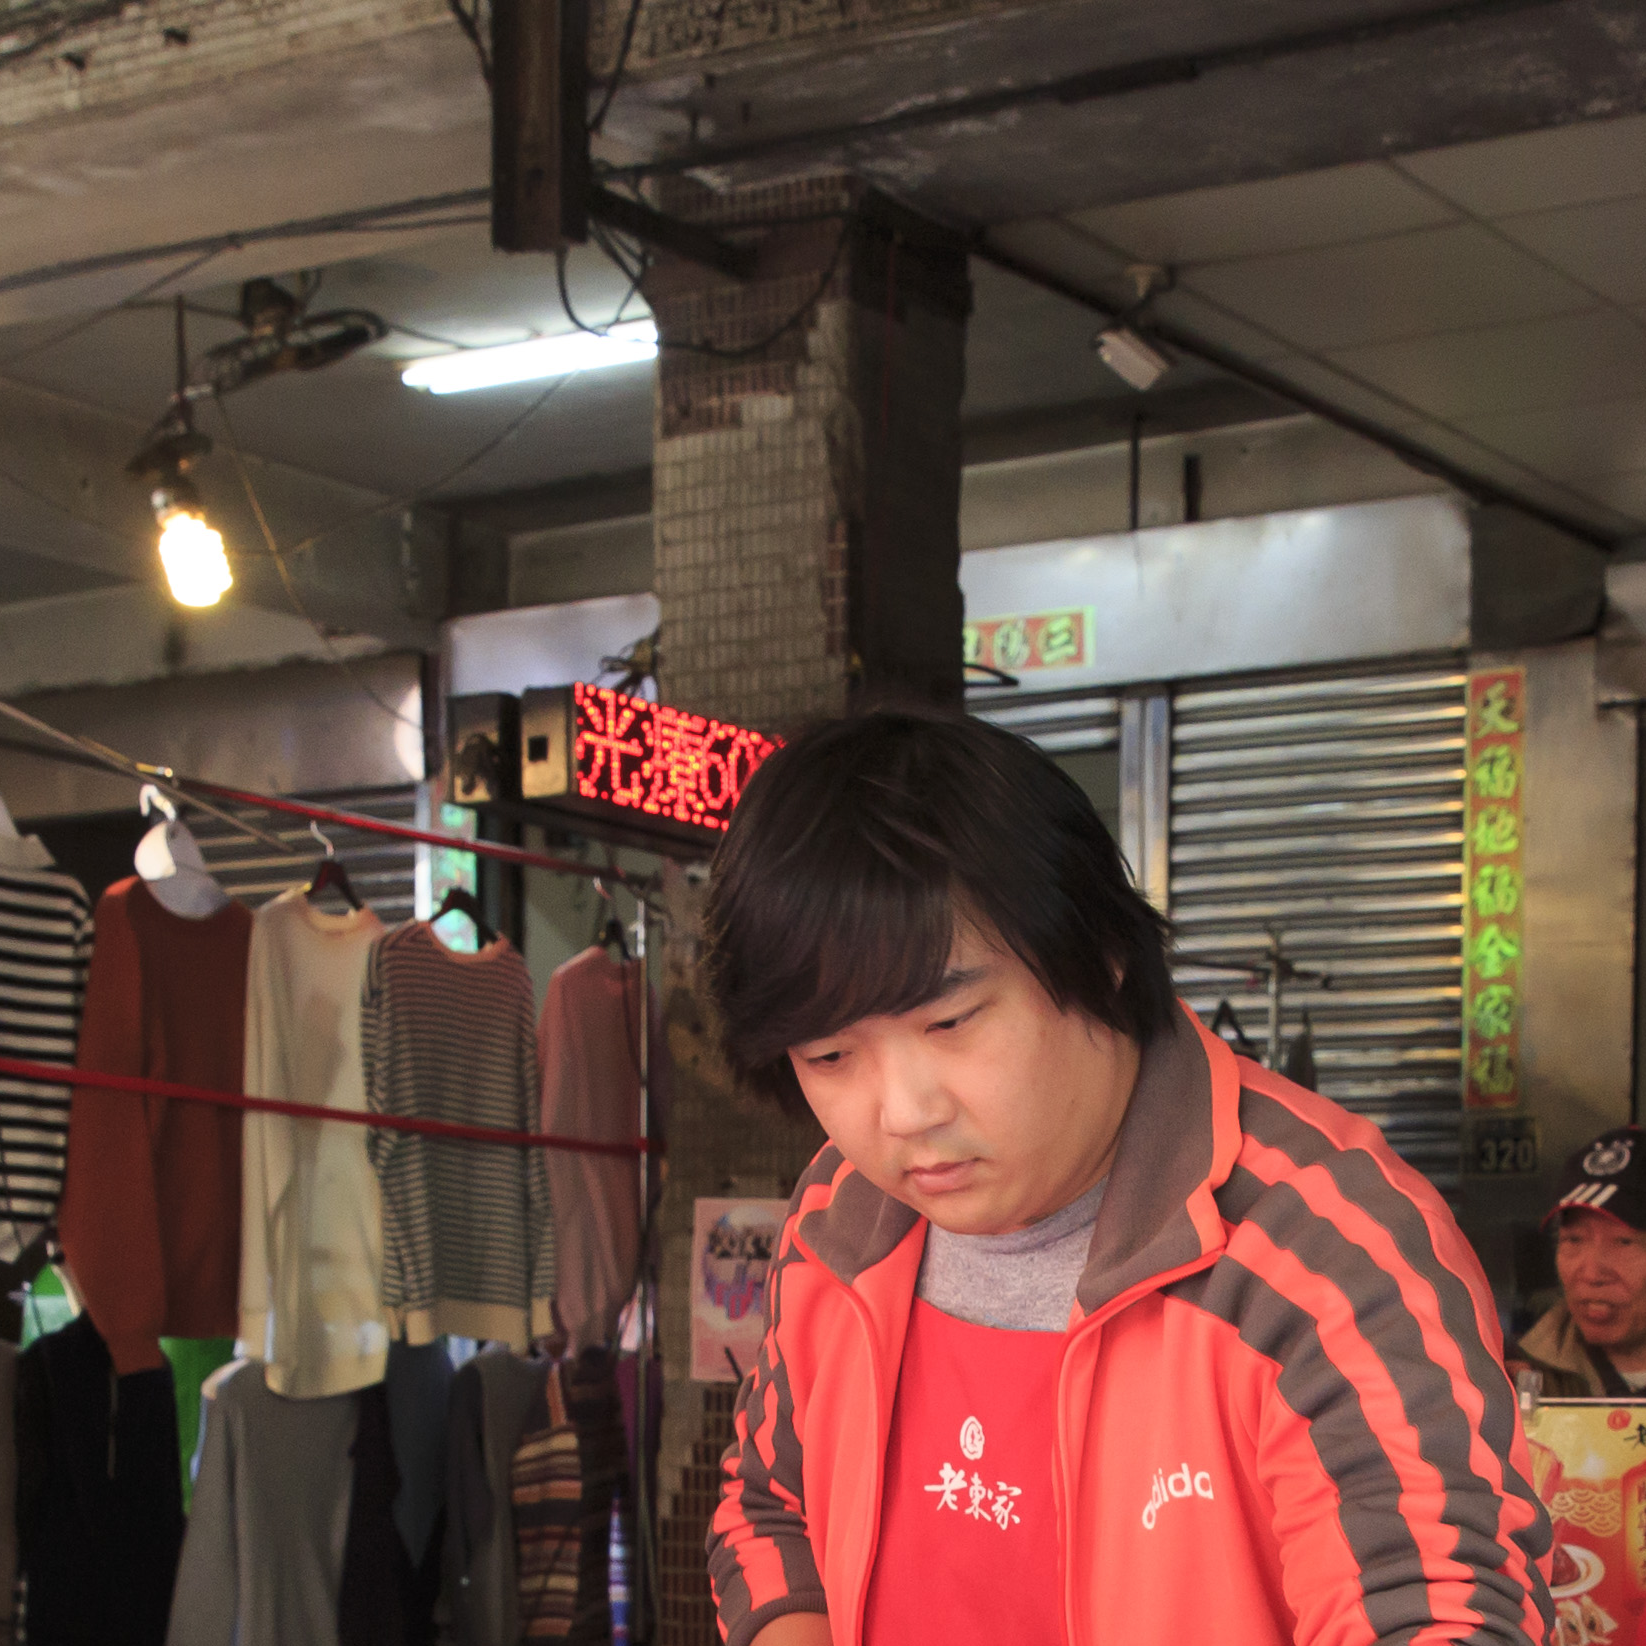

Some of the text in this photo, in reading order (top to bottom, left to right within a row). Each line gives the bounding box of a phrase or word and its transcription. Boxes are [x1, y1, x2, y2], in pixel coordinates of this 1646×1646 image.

[1480, 1138, 1534, 1172] 320
[924, 1462, 1022, 1531] 老東家
